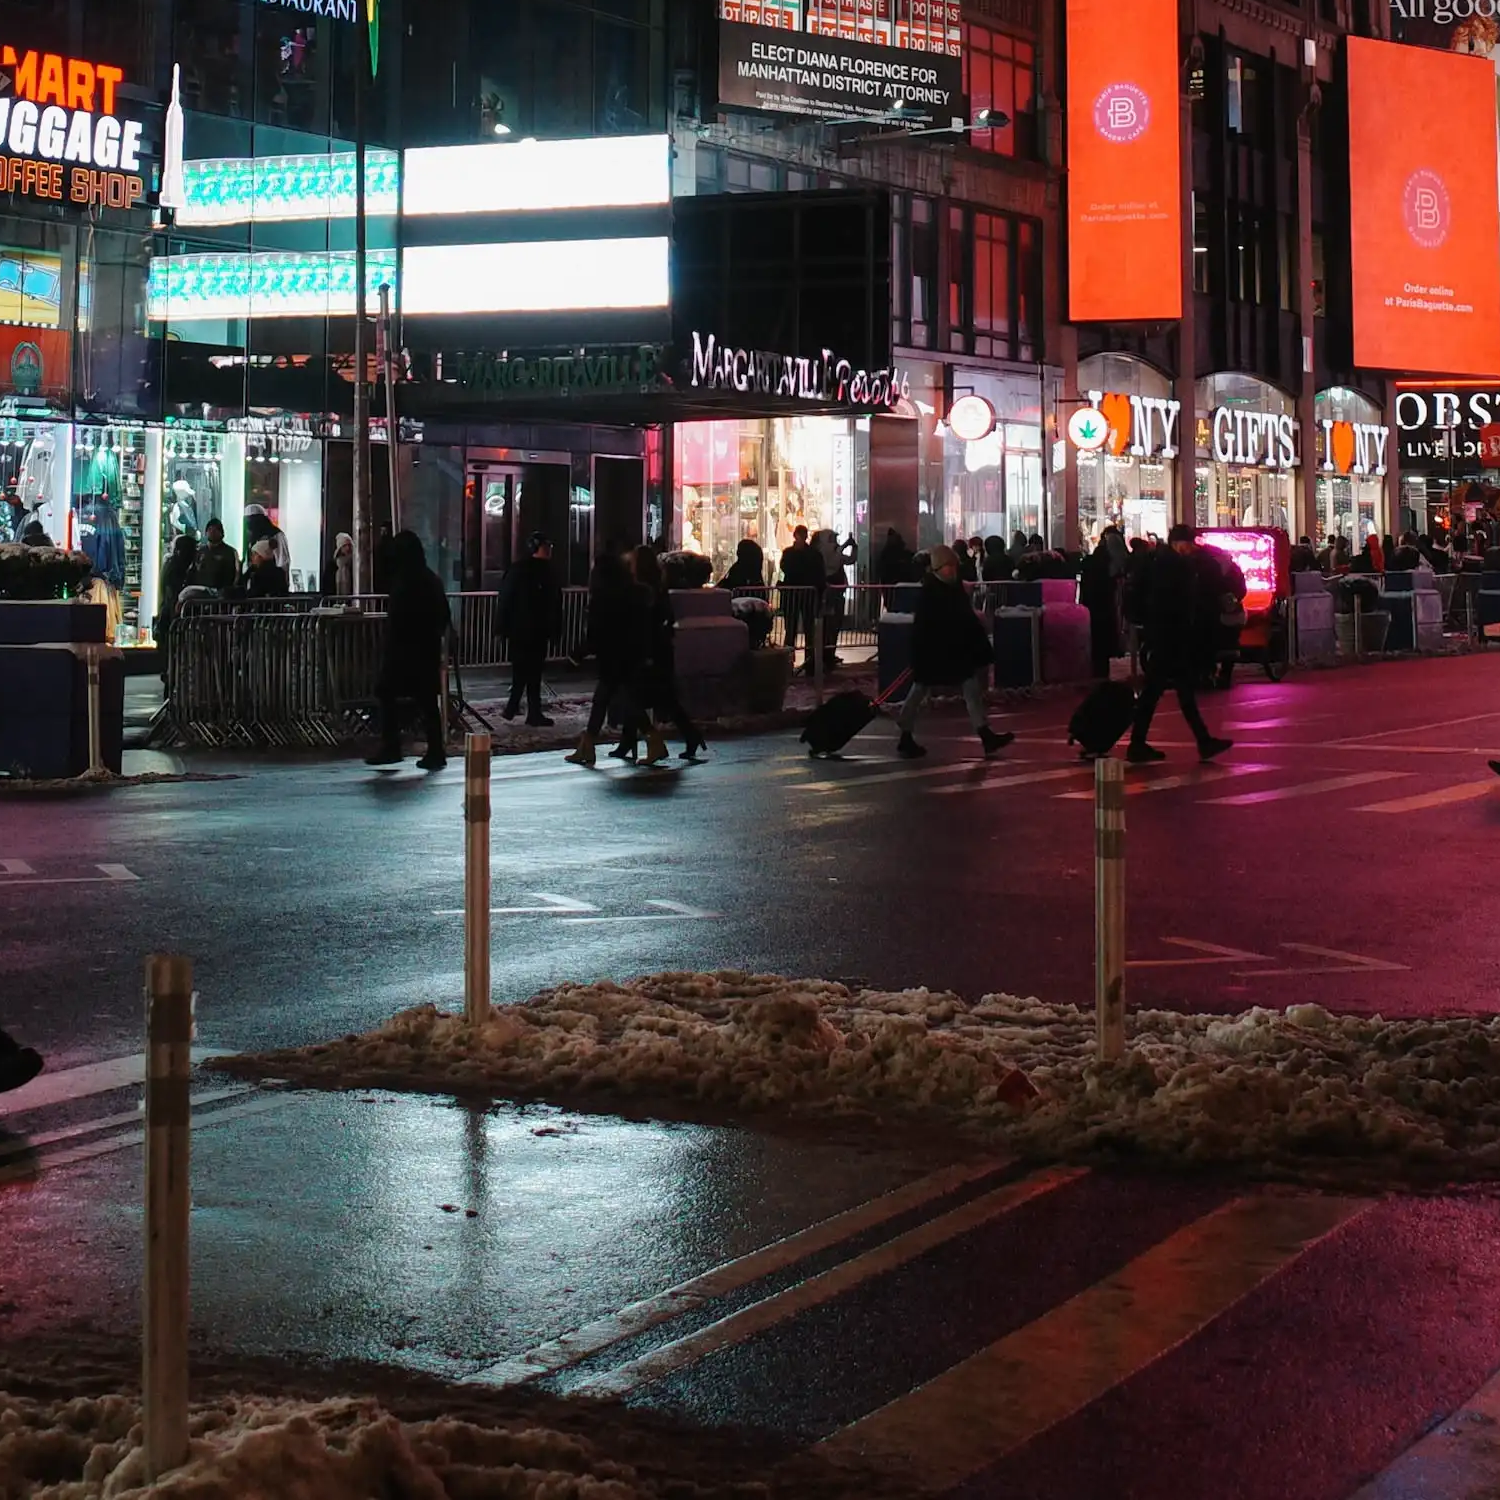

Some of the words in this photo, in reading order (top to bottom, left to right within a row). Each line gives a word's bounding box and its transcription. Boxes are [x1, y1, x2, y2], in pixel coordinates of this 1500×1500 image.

[737, 61, 820, 88] MANHATTAN
[822, 73, 881, 96] DISTRICT
[883, 81, 950, 105] ATTORNEY
[751, 42, 796, 65] ELECT
[797, 49, 838, 71] DIANA
[840, 57, 909, 81] FLORENCE
[911, 67, 938, 85] FOR
[71, 171, 144, 209] SHOP
[1403, 283, 1429, 294] Order
[691, 331, 836, 402] MARGARITAVILLE
[1129, 394, 1181, 460] NY
[1213, 405, 1296, 469] GIFTS
[1322, 418, 1334, 472] I
[1353, 422, 1390, 477] NY
[1407, 441, 1446, 458] LIVE
